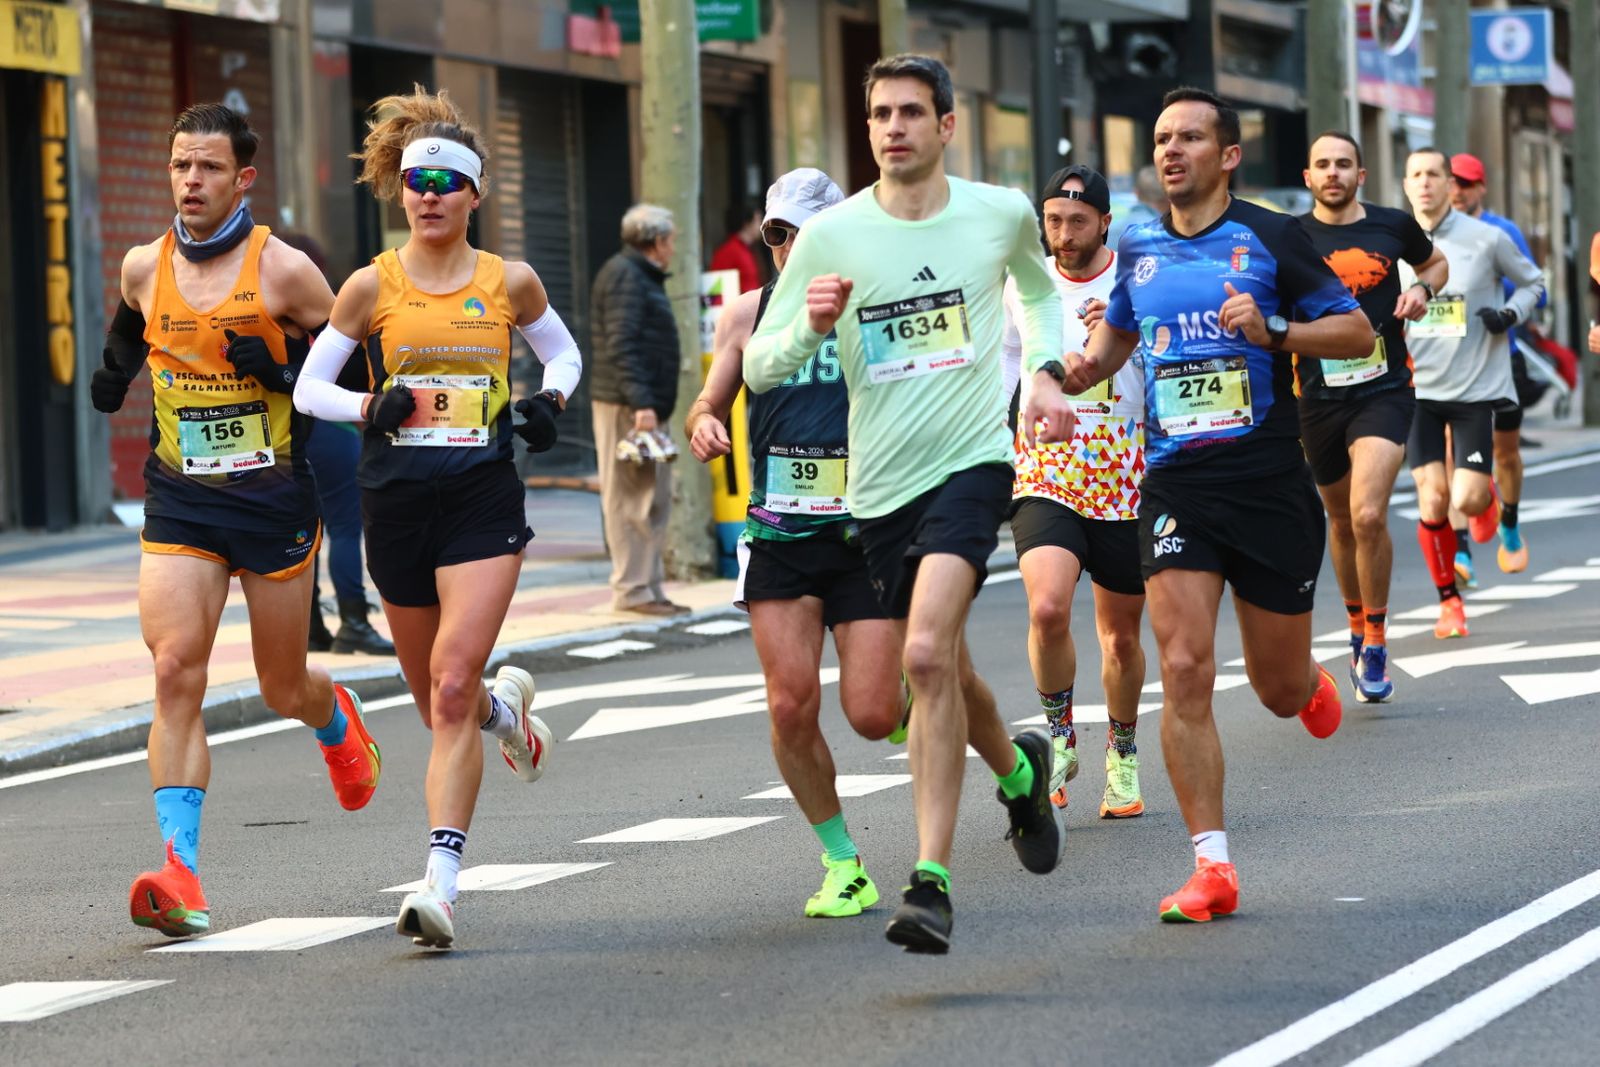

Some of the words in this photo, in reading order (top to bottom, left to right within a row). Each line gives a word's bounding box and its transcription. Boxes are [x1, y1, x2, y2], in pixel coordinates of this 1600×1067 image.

[882, 312, 949, 343] 1634
[418, 346, 449, 354] ESTER
[175, 372, 217, 382] ESCUELA
[183, 382, 257, 392] SALMANTINA
[1178, 376, 1223, 399] 274
[434, 393, 449, 412] 8
[201, 420, 245, 442] 156
[211, 442, 236, 451] ARTURO
[791, 461, 819, 480] 39
[810, 504, 842, 512] bedunia
[1153, 537, 1183, 558] MSC
